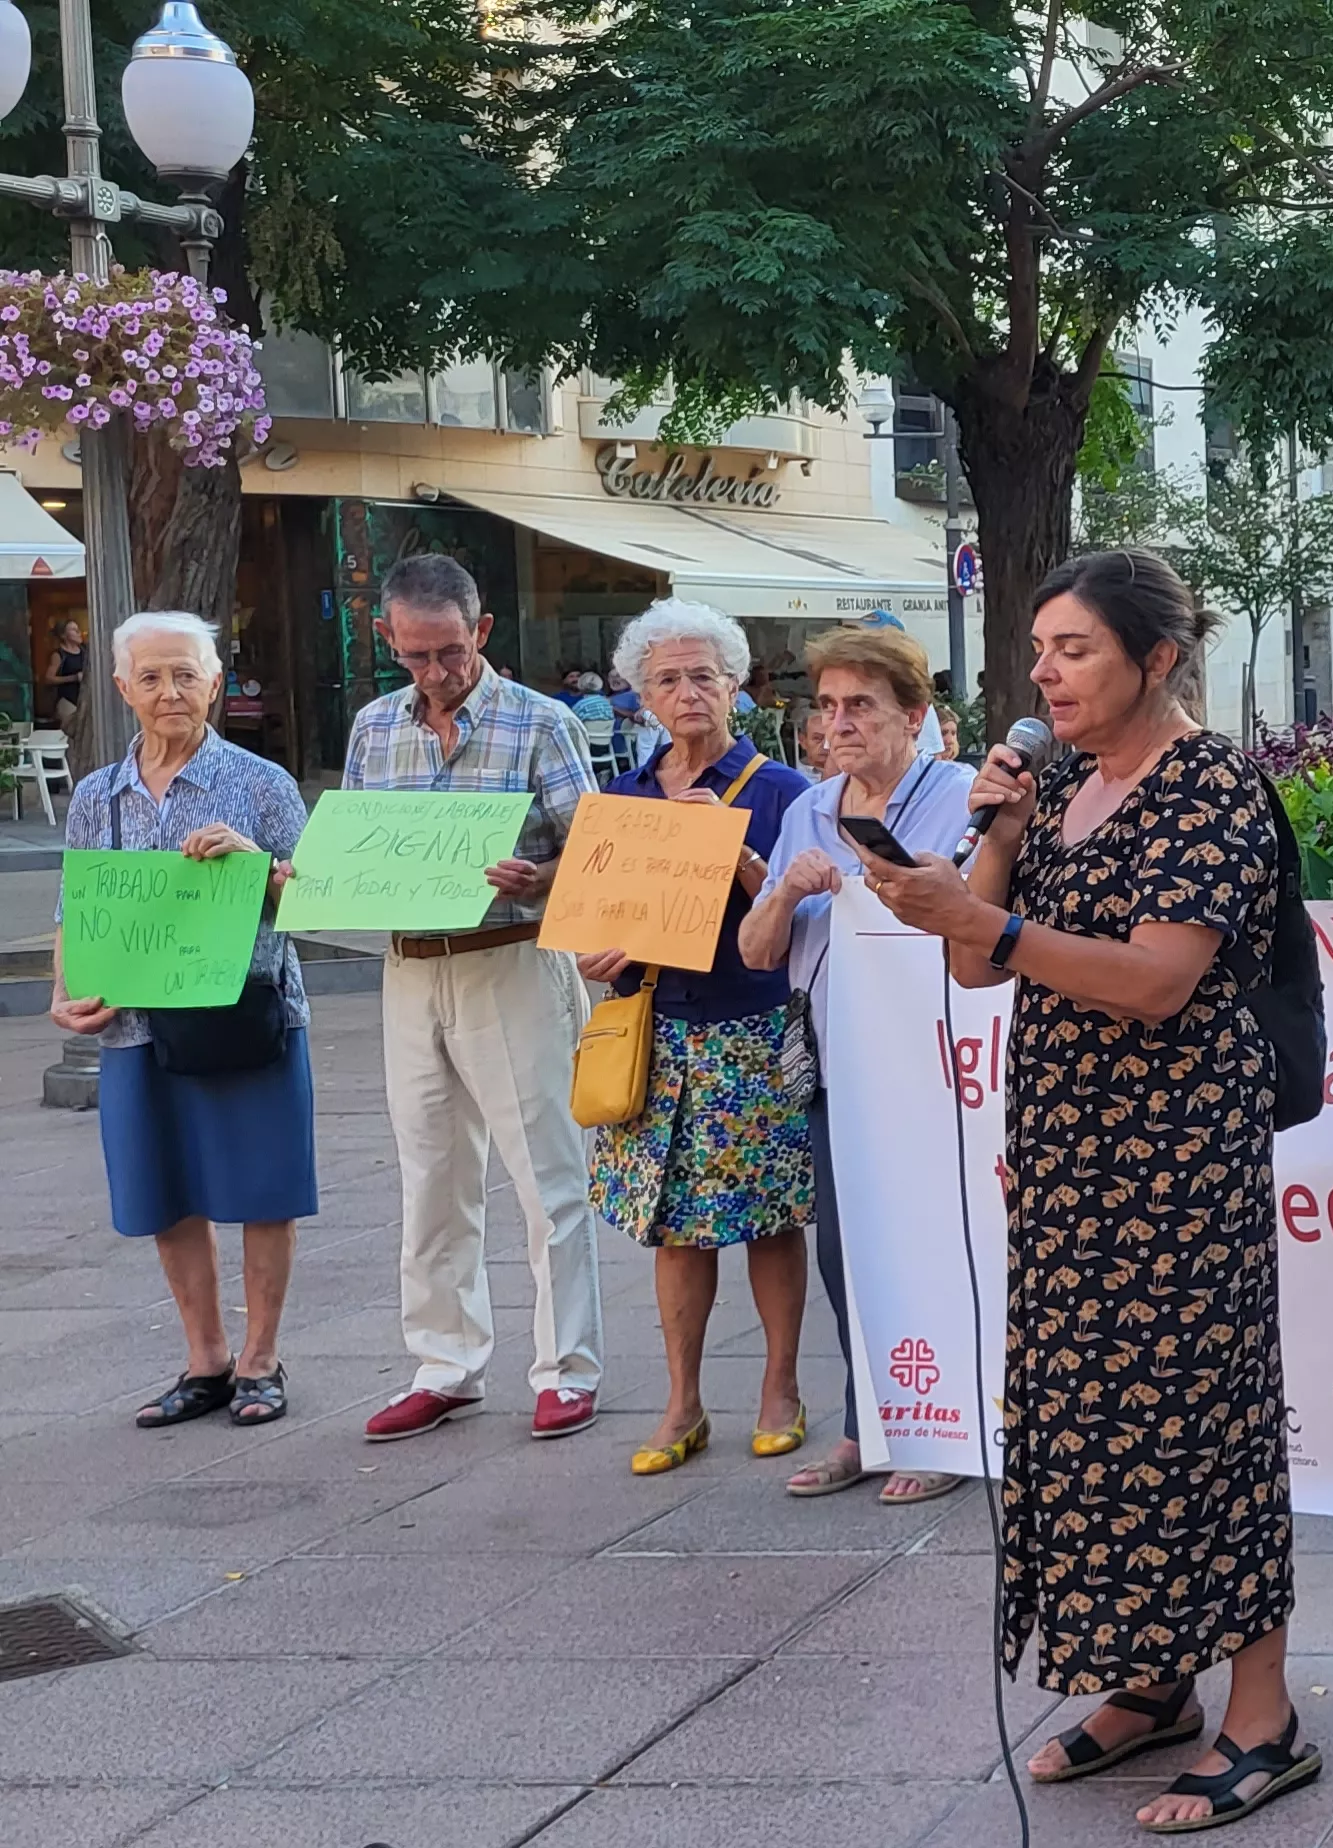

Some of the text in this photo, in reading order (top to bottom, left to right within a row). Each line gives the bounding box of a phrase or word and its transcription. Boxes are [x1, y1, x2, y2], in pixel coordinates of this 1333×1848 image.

[347, 555, 357, 569] 5
[434, 801, 524, 824] LABORALES
[345, 825, 504, 868] DIGNAS
[581, 838, 614, 877] NO
[87, 861, 168, 903] TRABAJO
[296, 875, 334, 900] PARA
[344, 869, 402, 899] TODAS
[661, 887, 720, 937] VIDA
[80, 906, 112, 943] NO
[120, 920, 178, 954] VIVIR
[878, 1400, 961, 1423] áritas
[914, 1426, 929, 1437] de
[932, 1428, 969, 1441] Huesca
